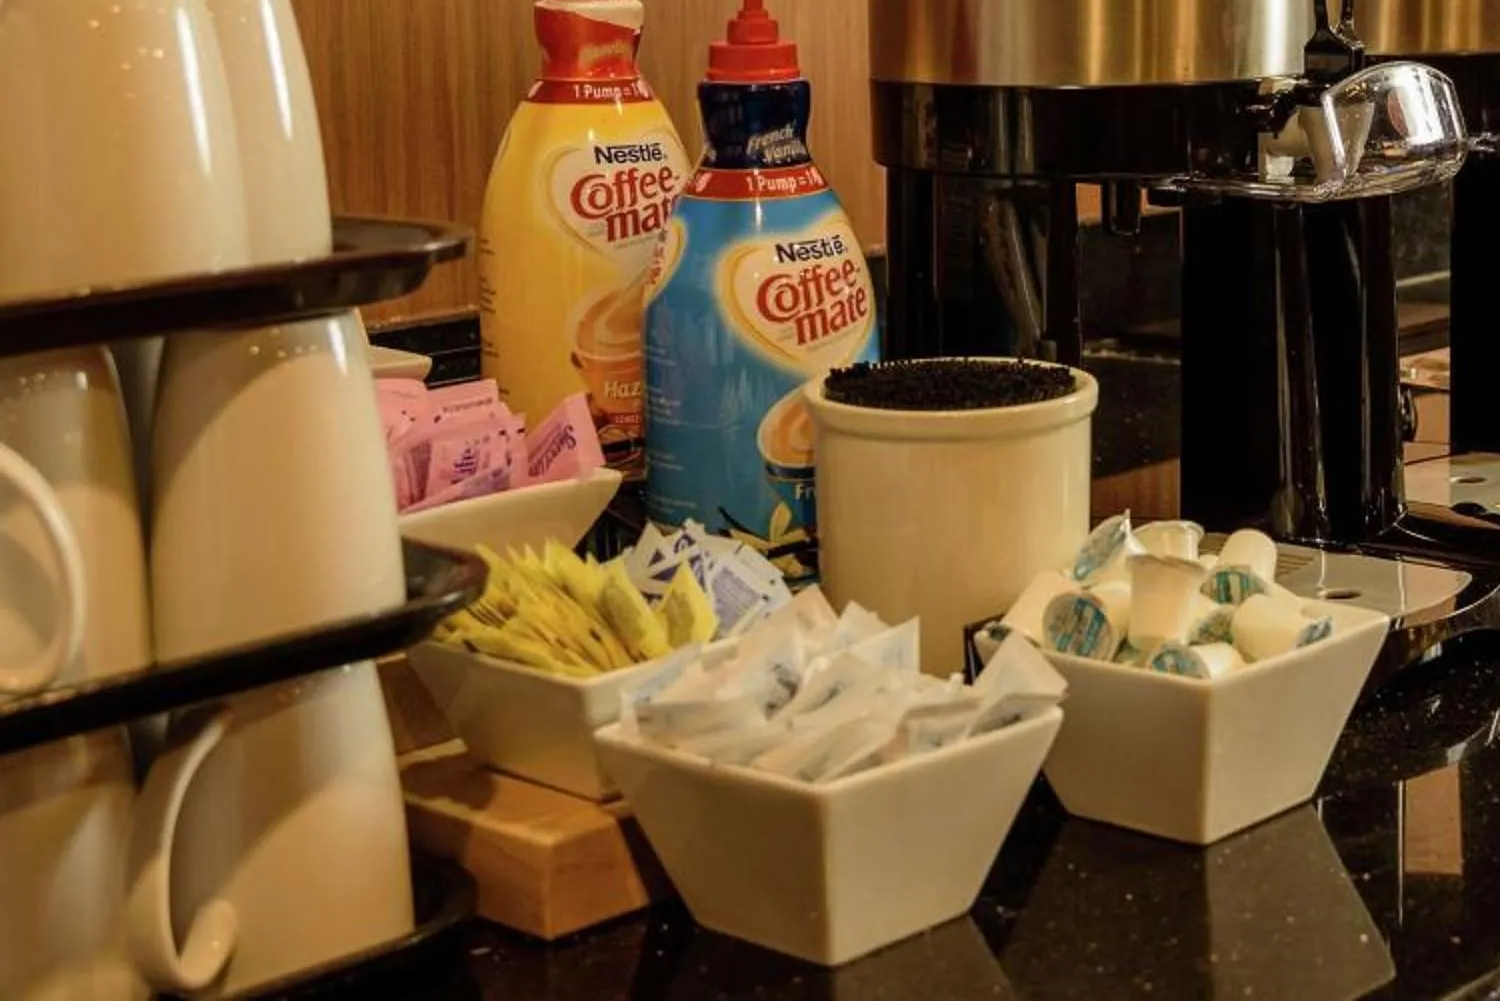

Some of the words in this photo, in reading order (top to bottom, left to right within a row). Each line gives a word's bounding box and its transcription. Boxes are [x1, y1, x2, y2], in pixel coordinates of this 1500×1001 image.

[758, 175, 797, 193] Pump
[606, 195, 678, 242] mat
[794, 287, 868, 345] mate
